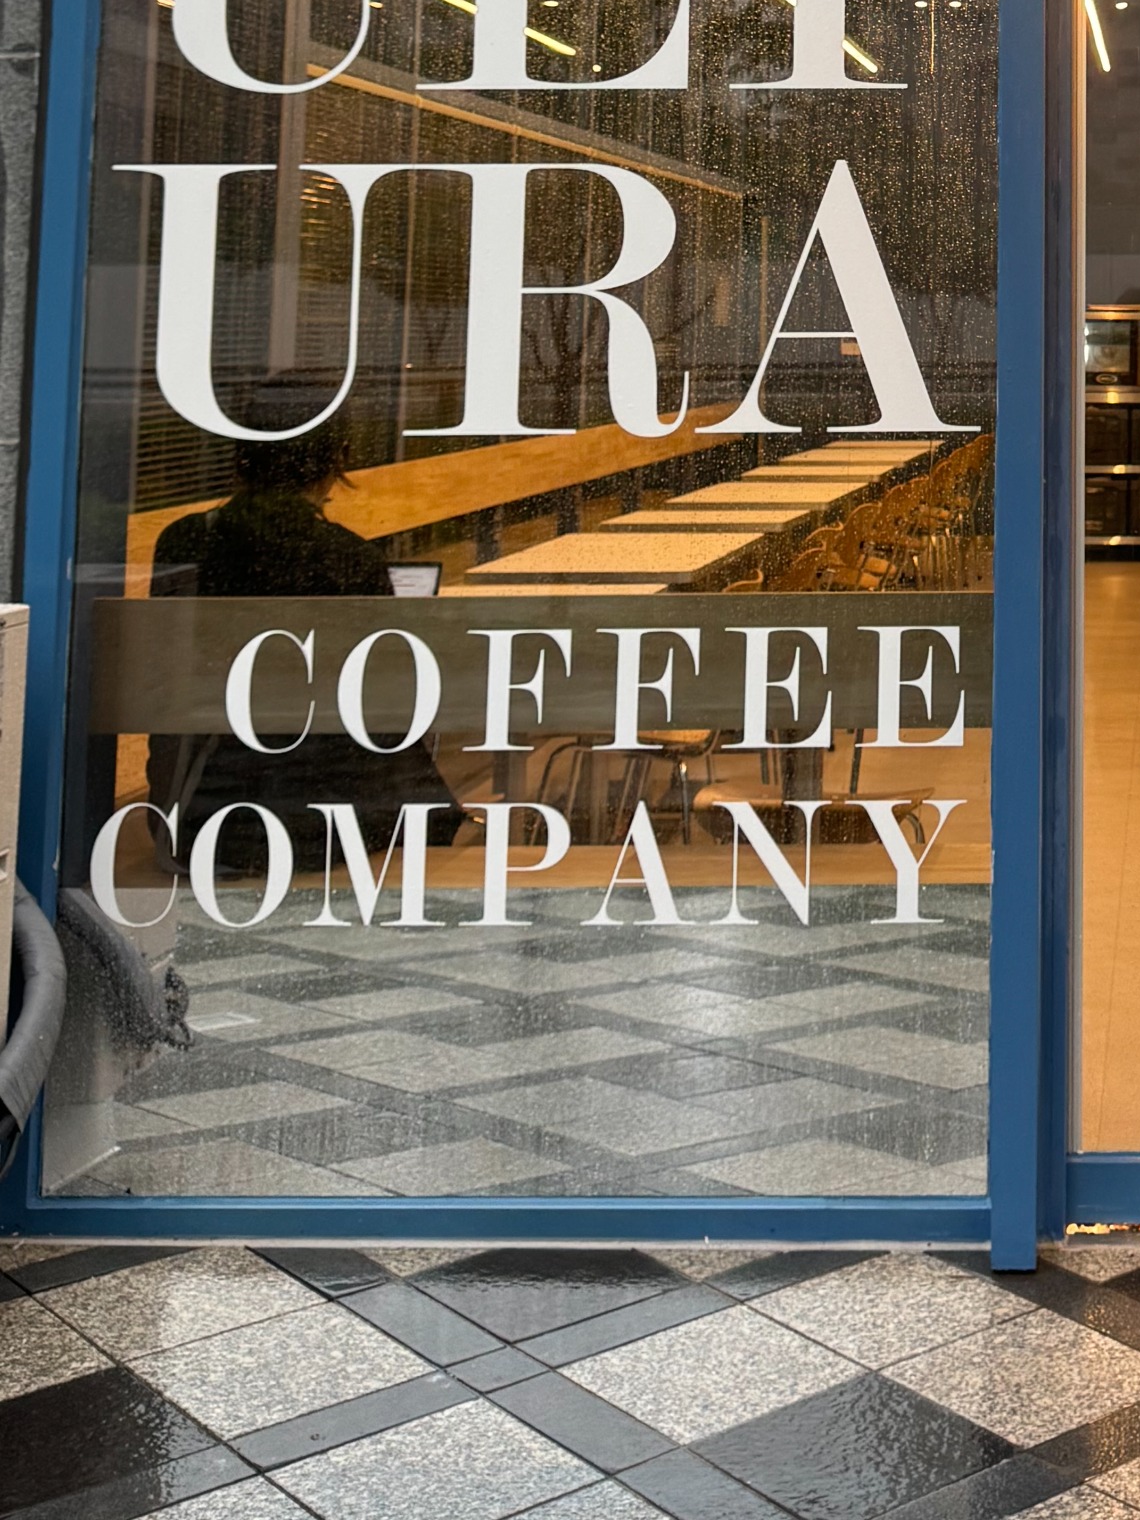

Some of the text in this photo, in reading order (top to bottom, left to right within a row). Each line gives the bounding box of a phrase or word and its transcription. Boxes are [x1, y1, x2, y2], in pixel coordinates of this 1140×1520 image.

[111, 159, 982, 442] URA
[224, 625, 967, 754] COFFEE
[89, 798, 969, 928] COMPANY
